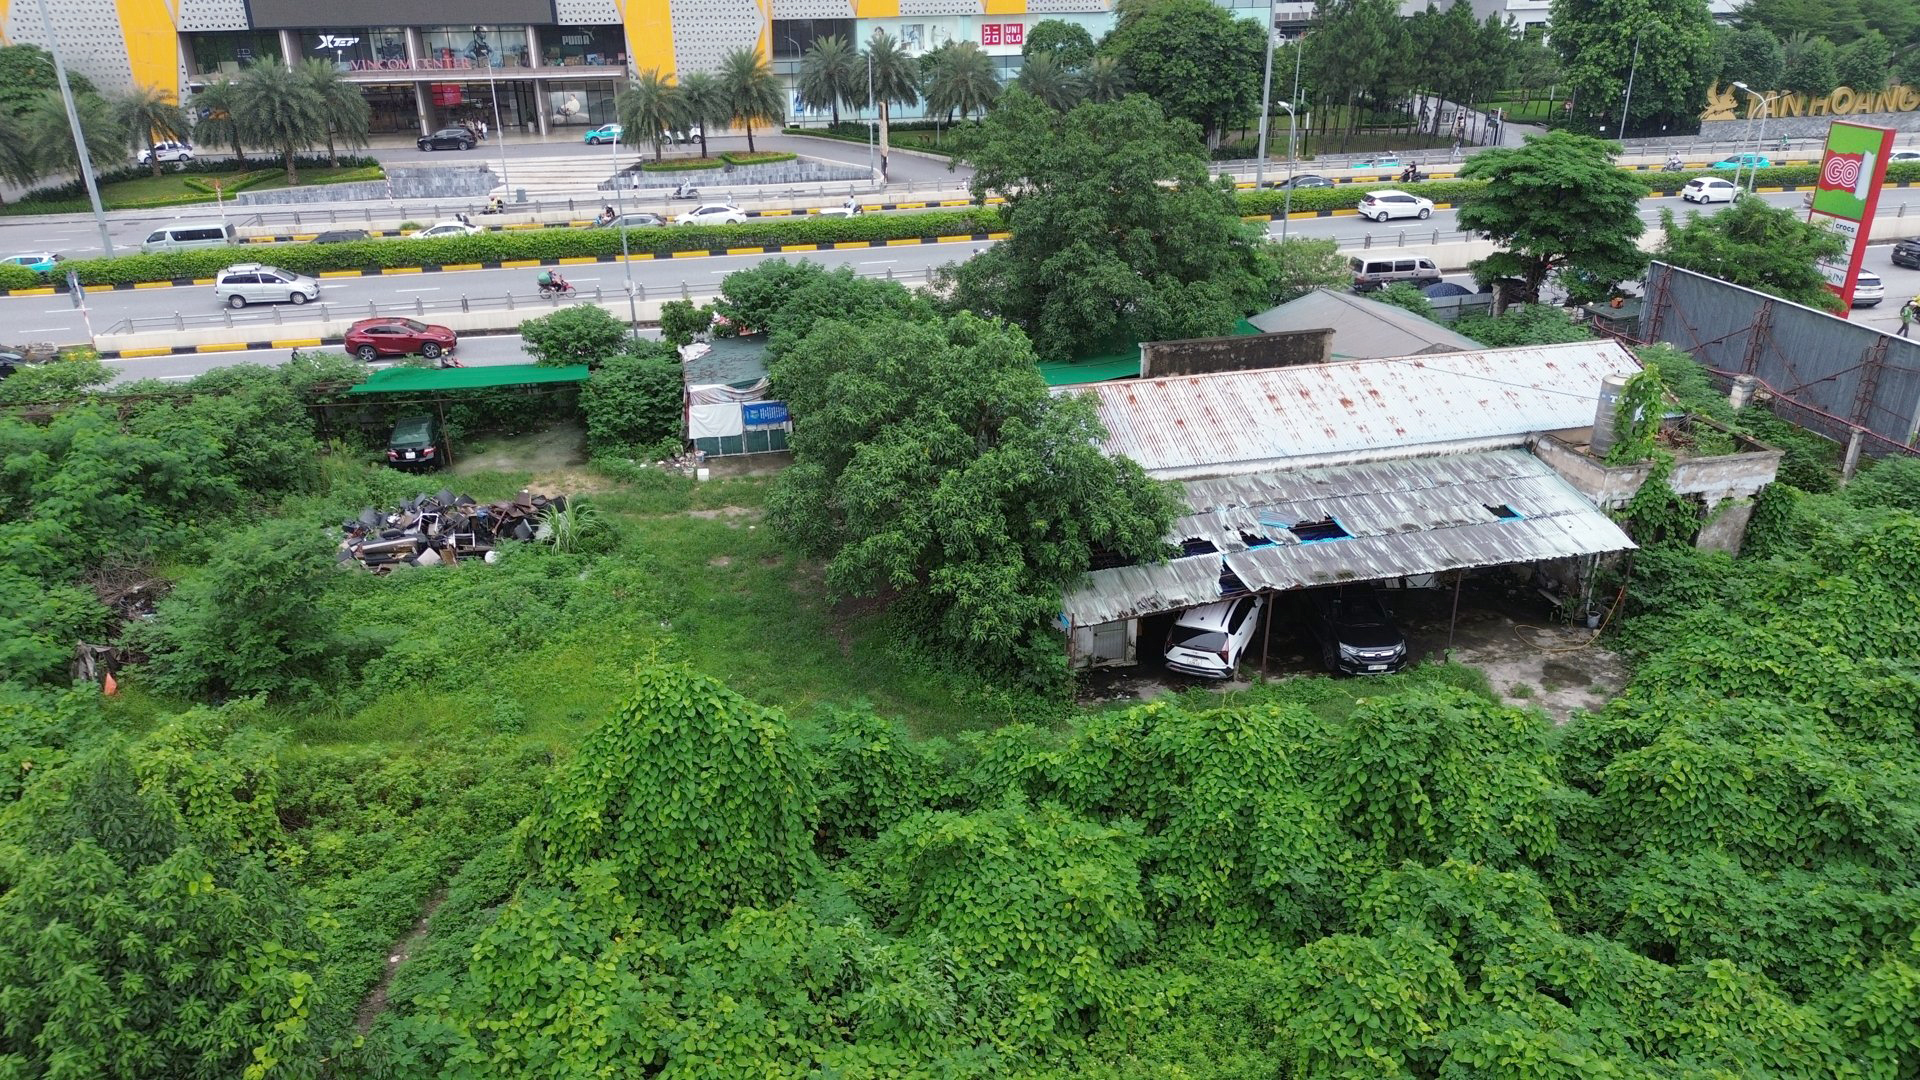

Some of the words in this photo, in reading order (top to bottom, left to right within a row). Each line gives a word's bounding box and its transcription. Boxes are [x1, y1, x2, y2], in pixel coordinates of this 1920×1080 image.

[1006, 26, 1020, 34] UNI
[562, 35, 590, 45] PUMA
[1006, 34, 1021, 43] QLO
[350, 58, 411, 70] VINCOM
[416, 58, 471, 70] CENTER
[1835, 223, 1855, 233] crocs
